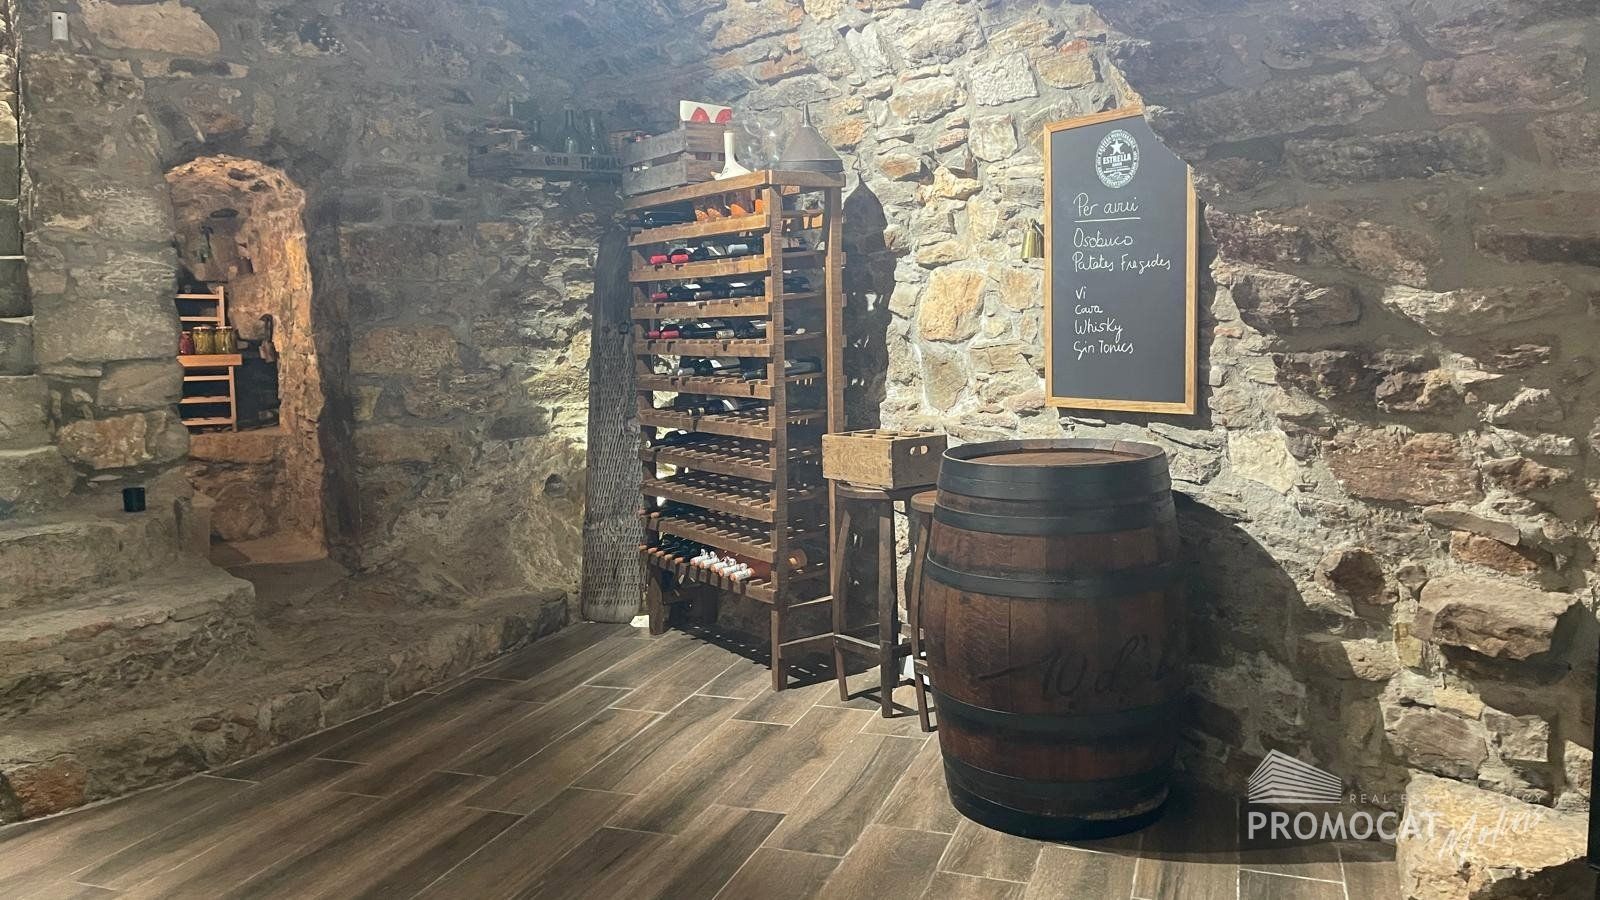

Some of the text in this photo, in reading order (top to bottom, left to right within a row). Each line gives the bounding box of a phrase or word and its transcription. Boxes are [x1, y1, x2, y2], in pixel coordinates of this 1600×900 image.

[1102, 153, 1131, 165] ESTRELLA
[1073, 192, 1099, 216] Per
[1073, 227, 1133, 248] Osobuco
[1072, 251, 1114, 272] Patates
[1073, 340, 1134, 360] Gin Tonics
